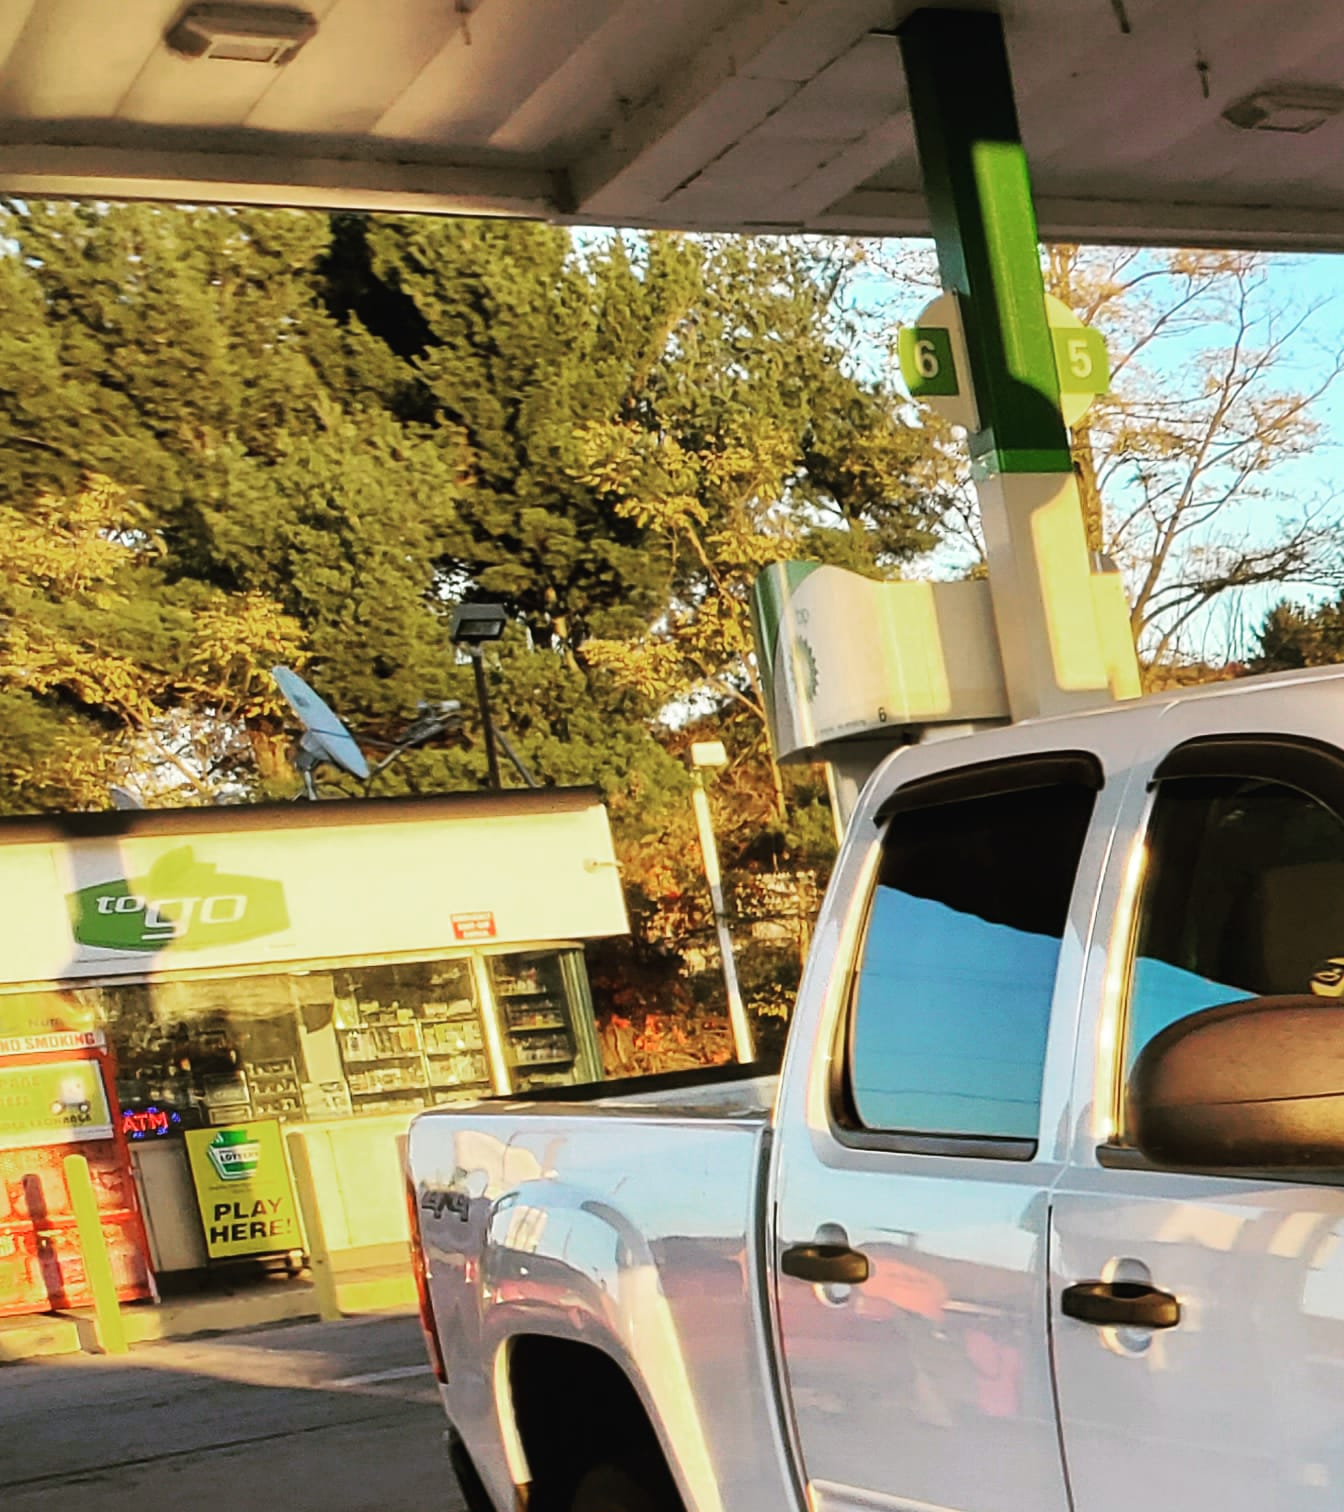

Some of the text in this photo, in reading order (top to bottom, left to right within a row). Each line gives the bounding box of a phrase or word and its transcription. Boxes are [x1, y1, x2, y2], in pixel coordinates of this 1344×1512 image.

[912, 339, 939, 379] 6
[1067, 339, 1093, 379] 5
[878, 706, 887, 722] 6
[97, 894, 247, 940] to go
[0, 1032, 96, 1053] NO SMOKING
[123, 1111, 169, 1134] ATM
[214, 1198, 283, 1222] PLAY
[210, 1218, 292, 1245] HERE!
